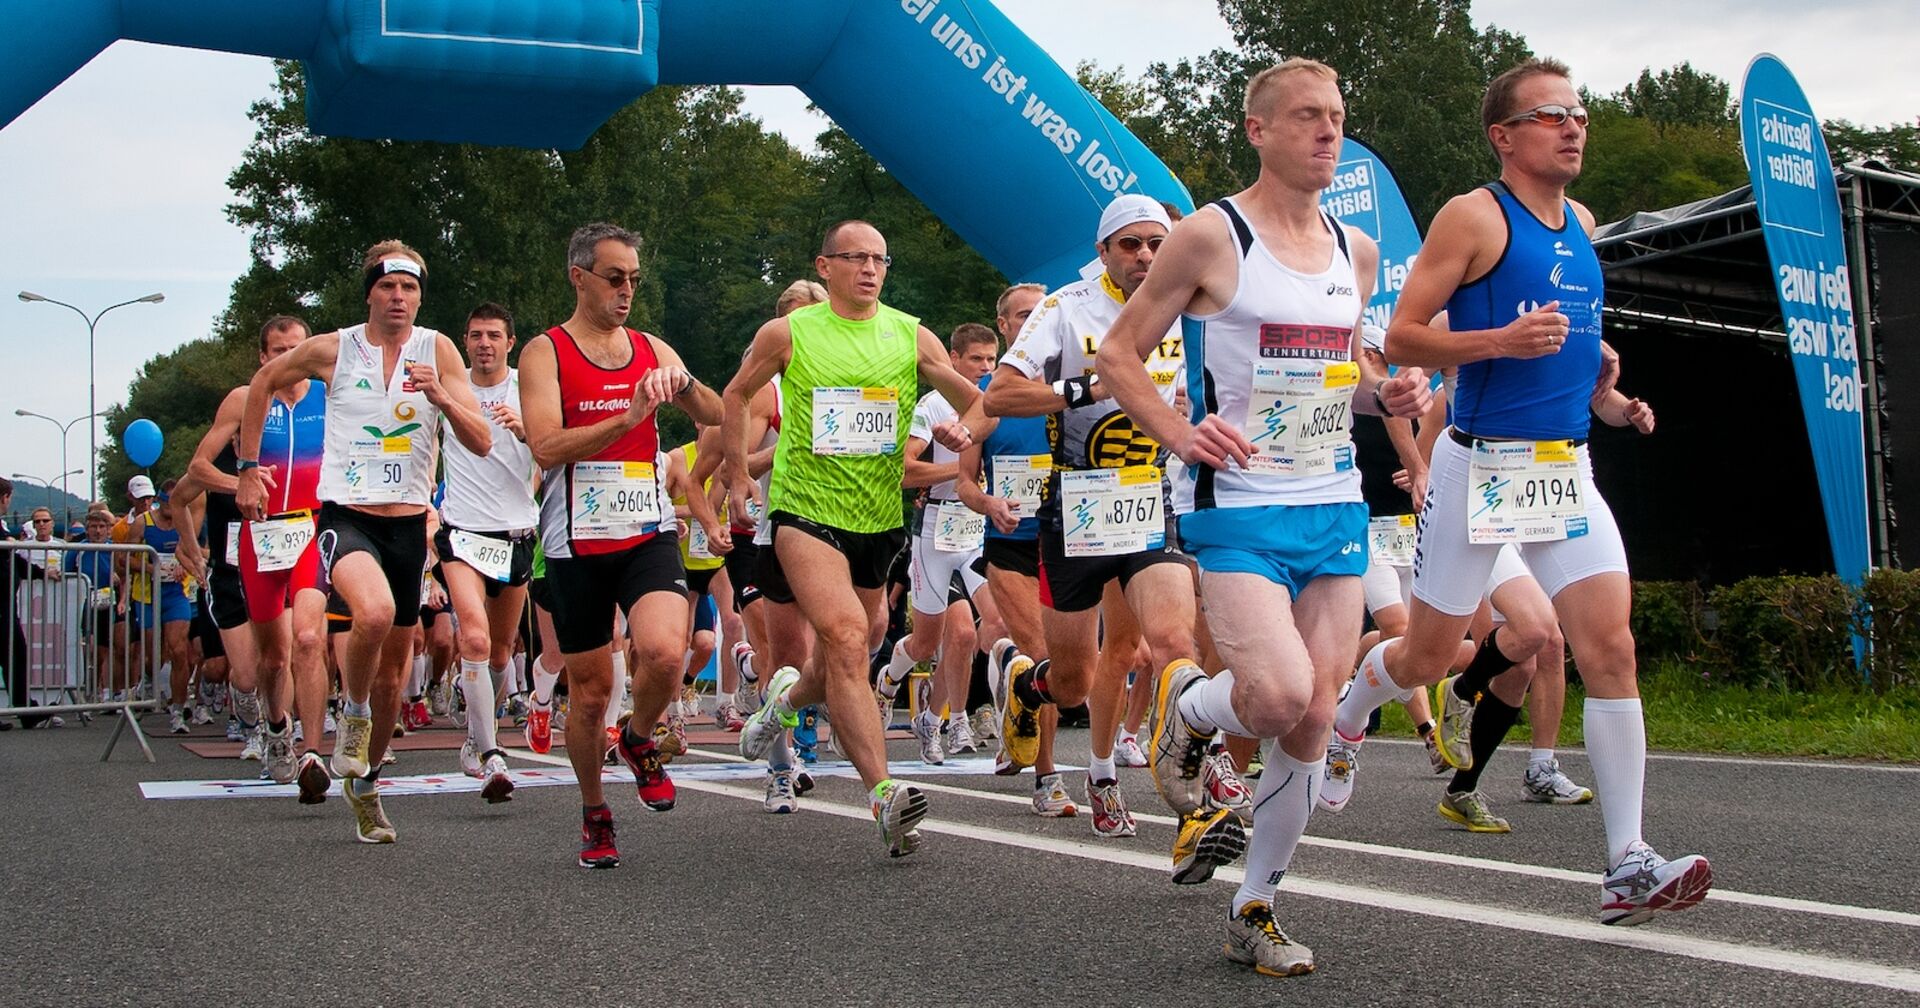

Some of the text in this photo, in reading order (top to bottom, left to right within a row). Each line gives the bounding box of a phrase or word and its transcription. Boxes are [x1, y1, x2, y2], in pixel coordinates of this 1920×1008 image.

[931, 13, 987, 69] uns
[982, 55, 1027, 105] ist
[1021, 93, 1082, 155] was
[1076, 140, 1138, 199] los!
[1264, 326, 1352, 345] SPORT
[849, 412, 893, 433] M9304
[1300, 401, 1346, 439] M8682
[383, 464, 402, 483] 50
[610, 490, 653, 513] M9604
[1515, 478, 1578, 508] M9194
[1105, 497, 1157, 525] M8767
[1524, 527, 1556, 536] GERHARD
